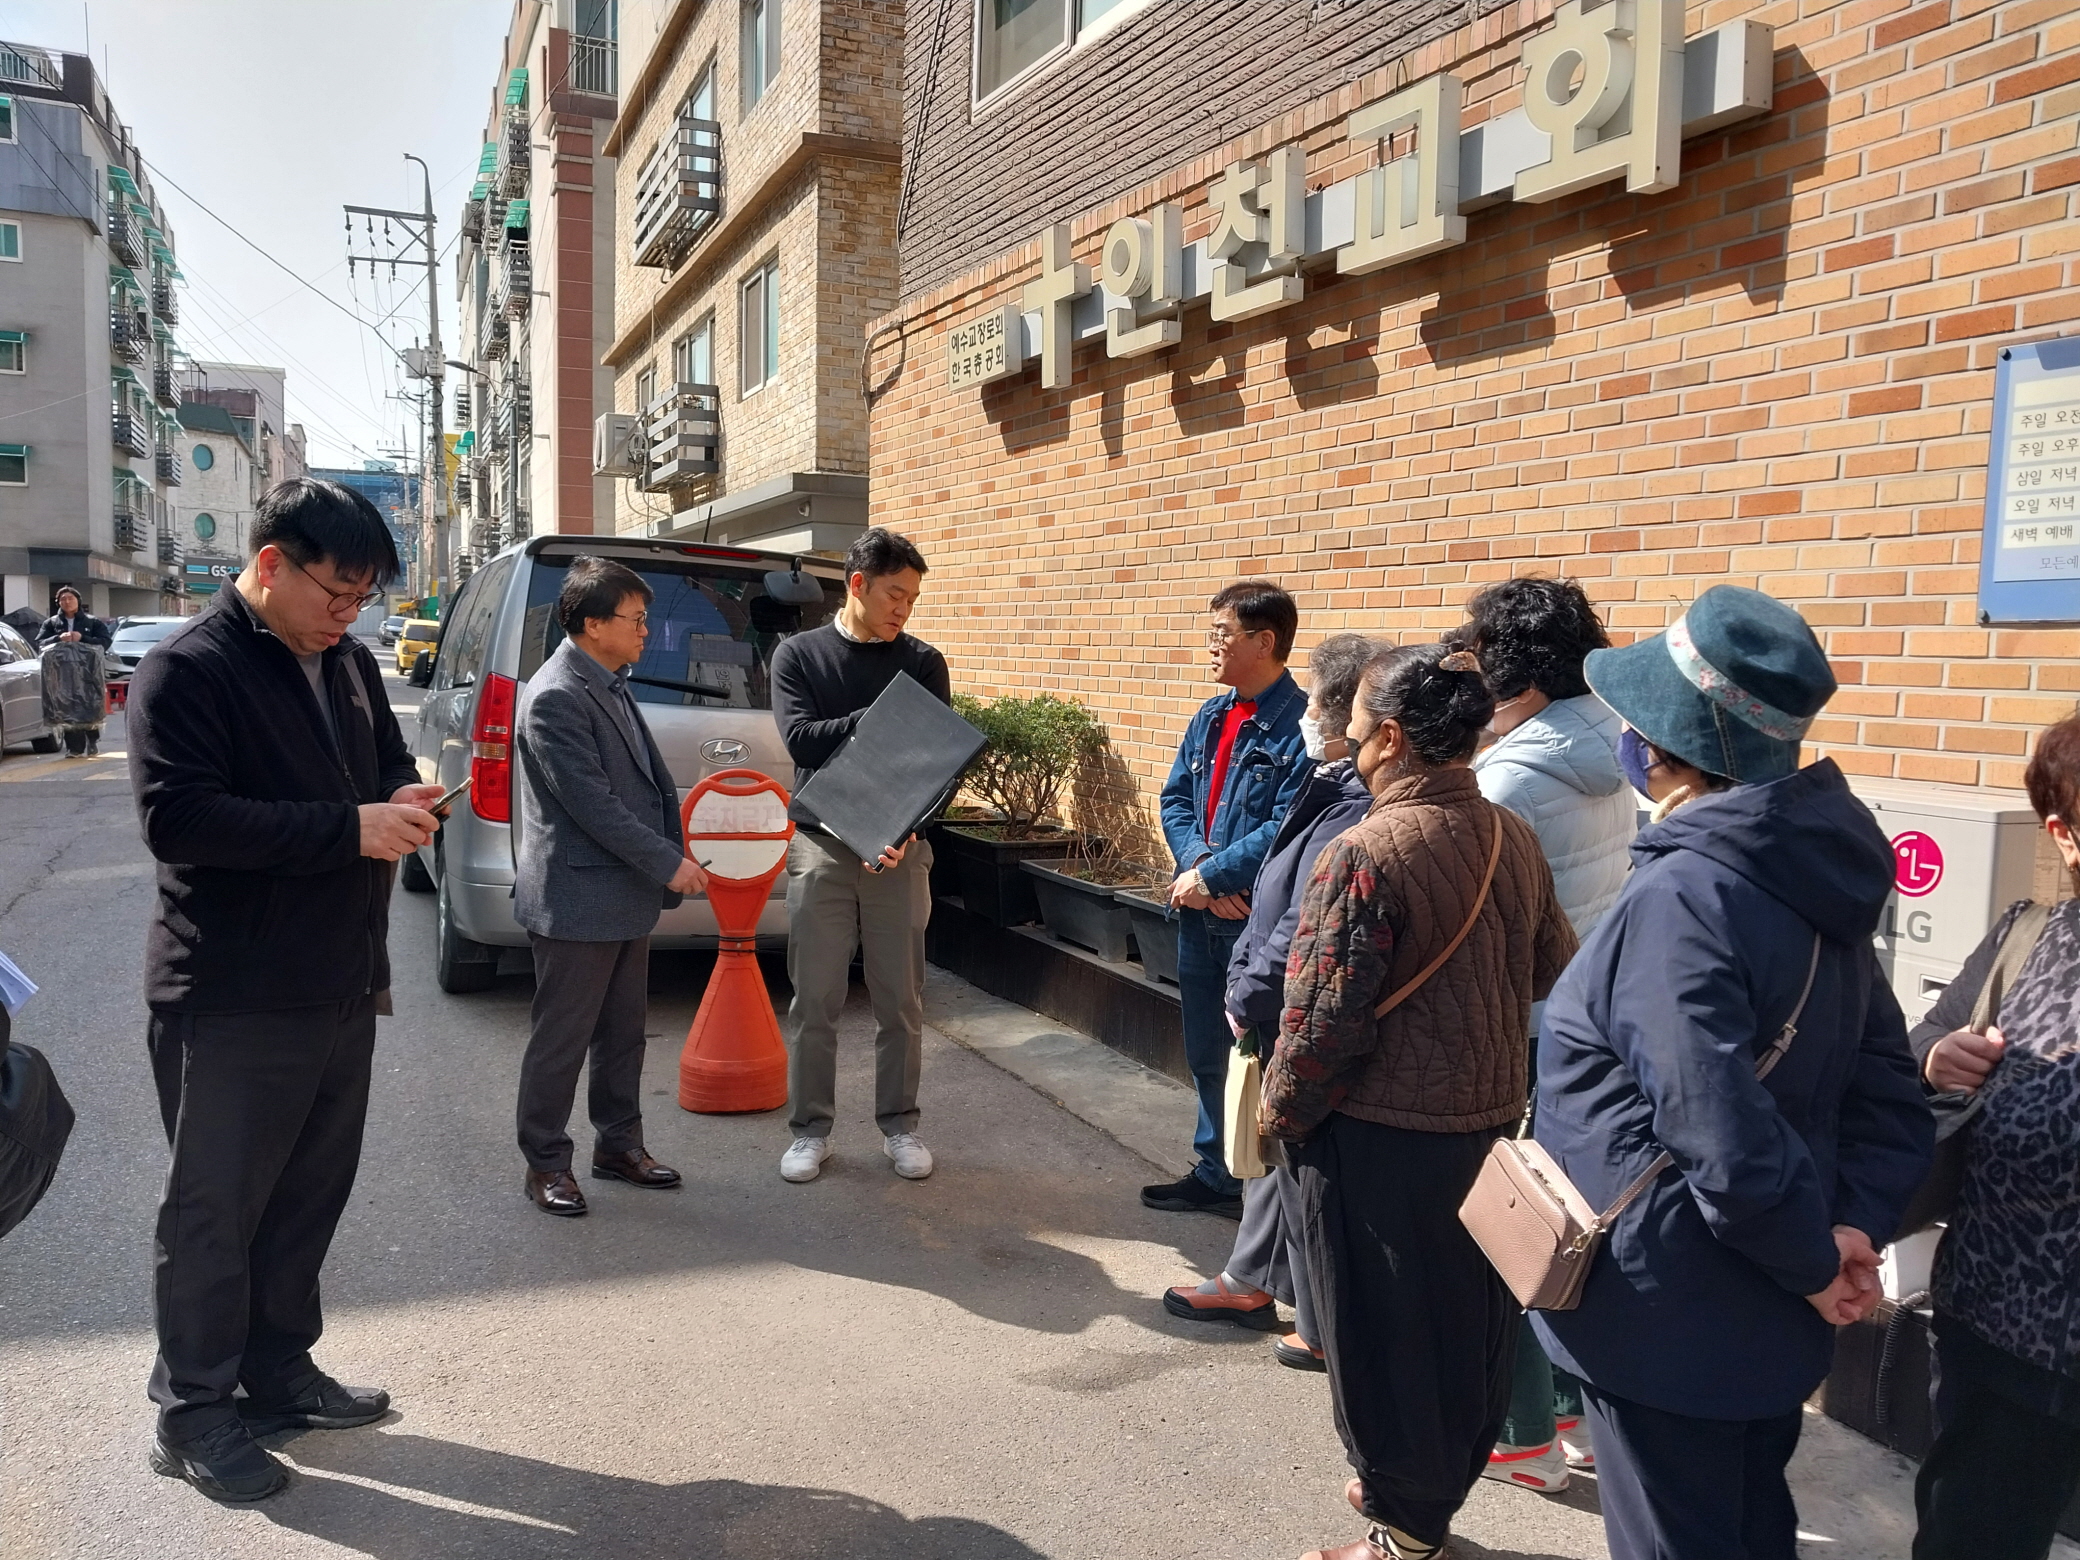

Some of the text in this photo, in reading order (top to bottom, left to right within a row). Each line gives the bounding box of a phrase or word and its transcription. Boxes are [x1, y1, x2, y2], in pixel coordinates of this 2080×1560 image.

[951, 313, 1004, 355] 예수교장로회
[952, 343, 1004, 384] 한국총공회
[2020, 412, 2047, 429] 주일
[2018, 437, 2079, 457] 주일 오후
[2016, 466, 2077, 487] 삼일 저녁
[2013, 495, 2075, 514] 오일 저녁
[2010, 524, 2073, 542] 새벽 예배
[1885, 905, 1932, 944] LG
